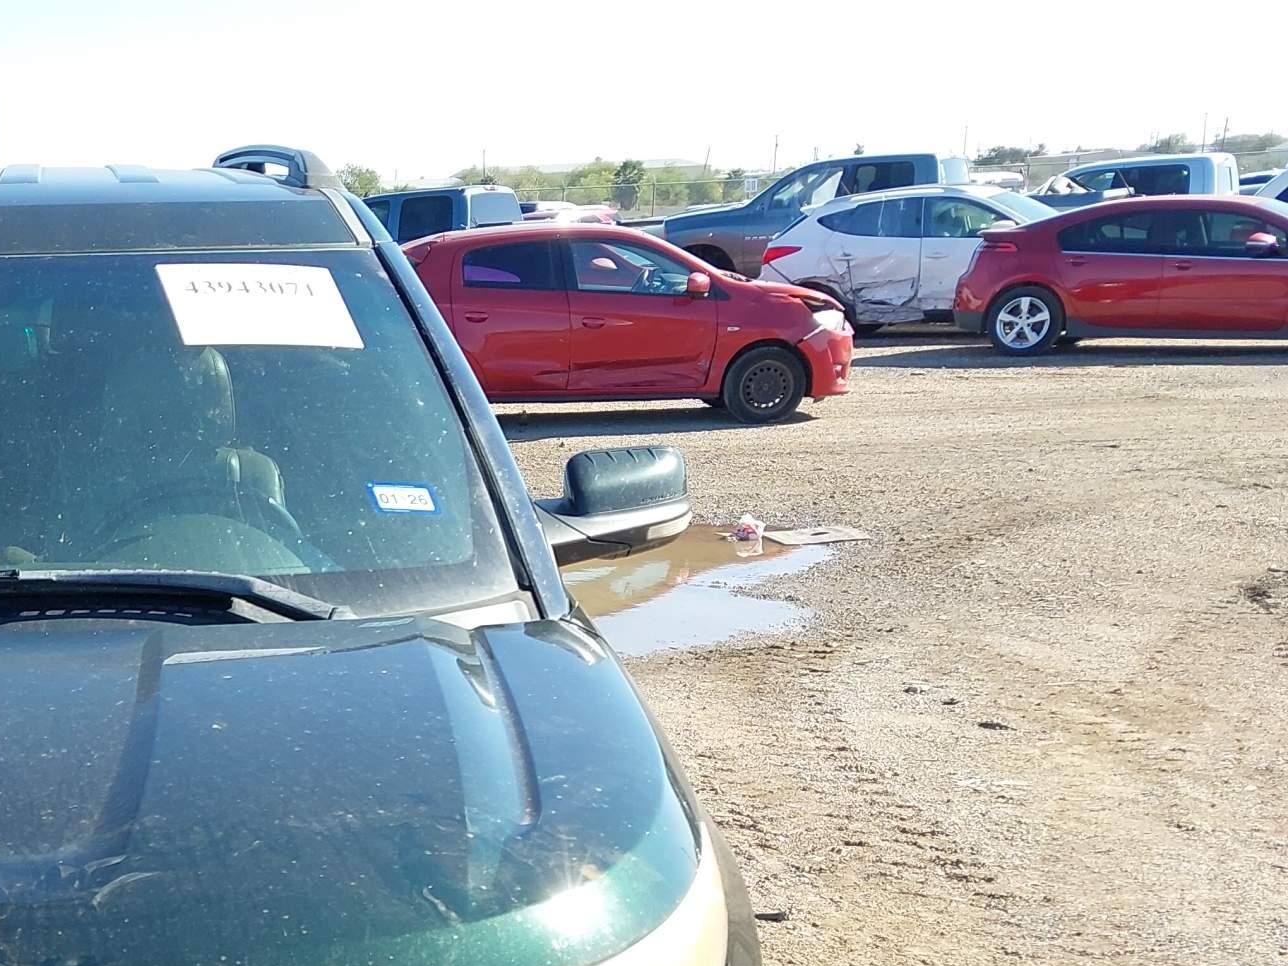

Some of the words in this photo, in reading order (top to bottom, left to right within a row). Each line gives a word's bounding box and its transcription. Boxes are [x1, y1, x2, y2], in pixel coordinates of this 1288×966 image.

[184, 280, 315, 297] 43943071
[379, 493, 398, 505] 01
[407, 494, 429, 506] 26
